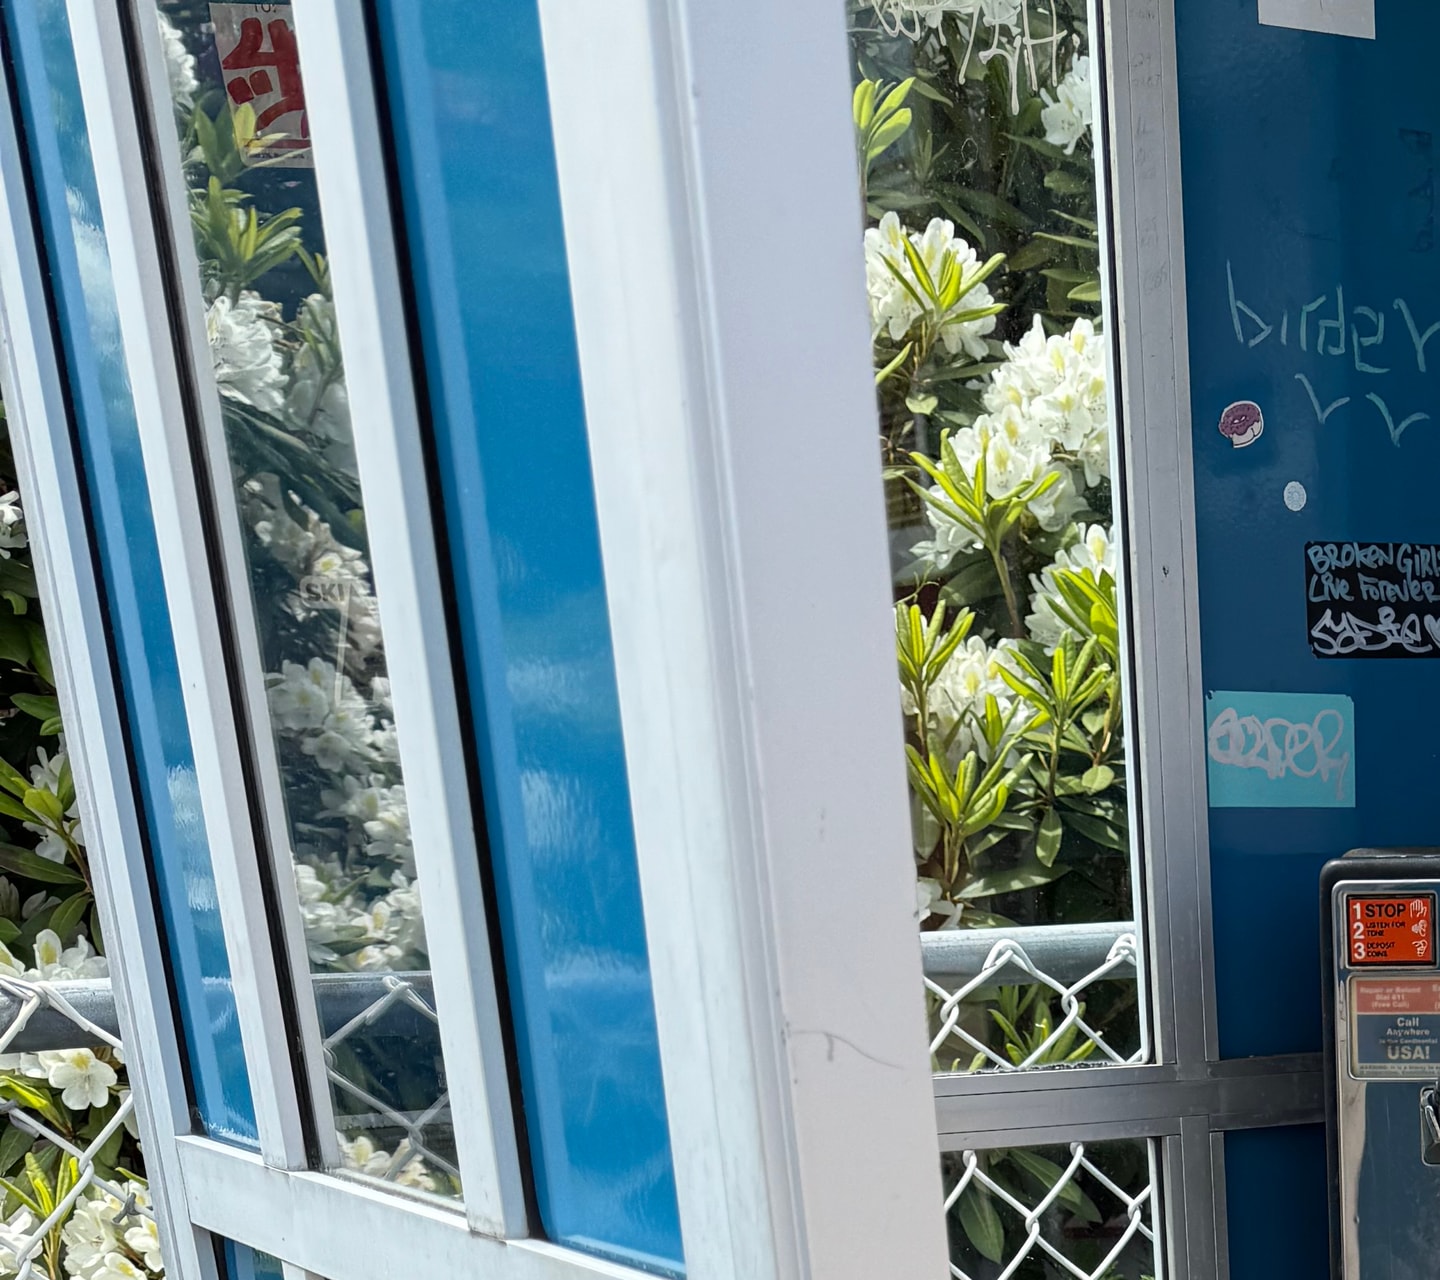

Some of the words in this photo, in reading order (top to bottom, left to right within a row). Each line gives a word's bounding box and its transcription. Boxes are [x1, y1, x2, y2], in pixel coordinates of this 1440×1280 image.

[1353, 902, 1361, 920] 1
[1365, 903, 1406, 918] STOP
[1353, 922, 1365, 940] 2
[1392, 921, 1406, 929] FOR
[1354, 942, 1366, 960] 3
[1367, 941, 1396, 950] DEPOSIT
[1396, 1017, 1420, 1027] Call
[1386, 1028, 1431, 1037] Anywhere
[1386, 1045, 1431, 1060] USA!
